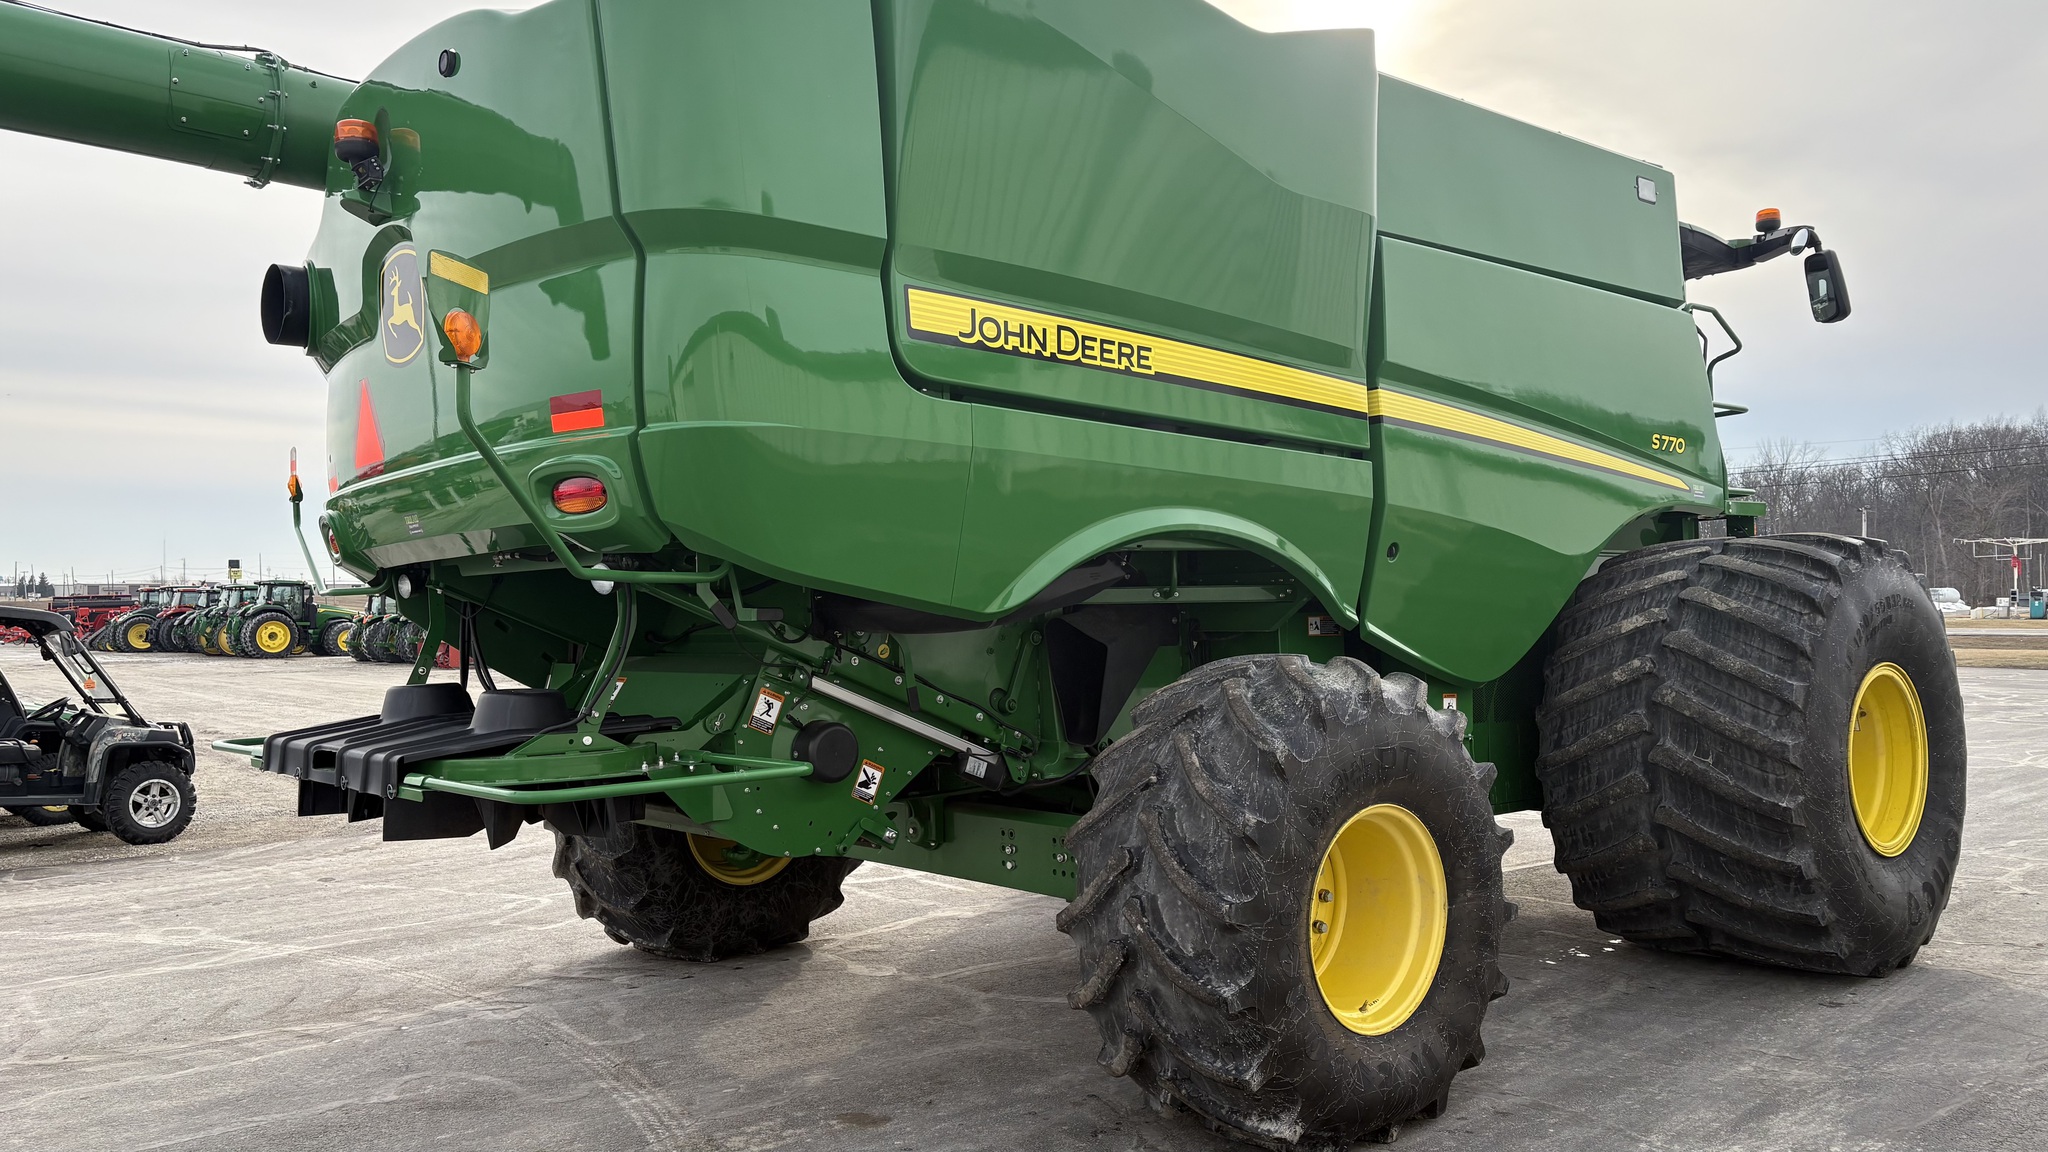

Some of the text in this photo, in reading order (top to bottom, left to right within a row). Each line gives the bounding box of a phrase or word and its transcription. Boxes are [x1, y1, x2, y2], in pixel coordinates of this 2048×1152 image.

[957, 307, 1153, 372] JOHN DEERE
[1651, 433, 1686, 454] S770
